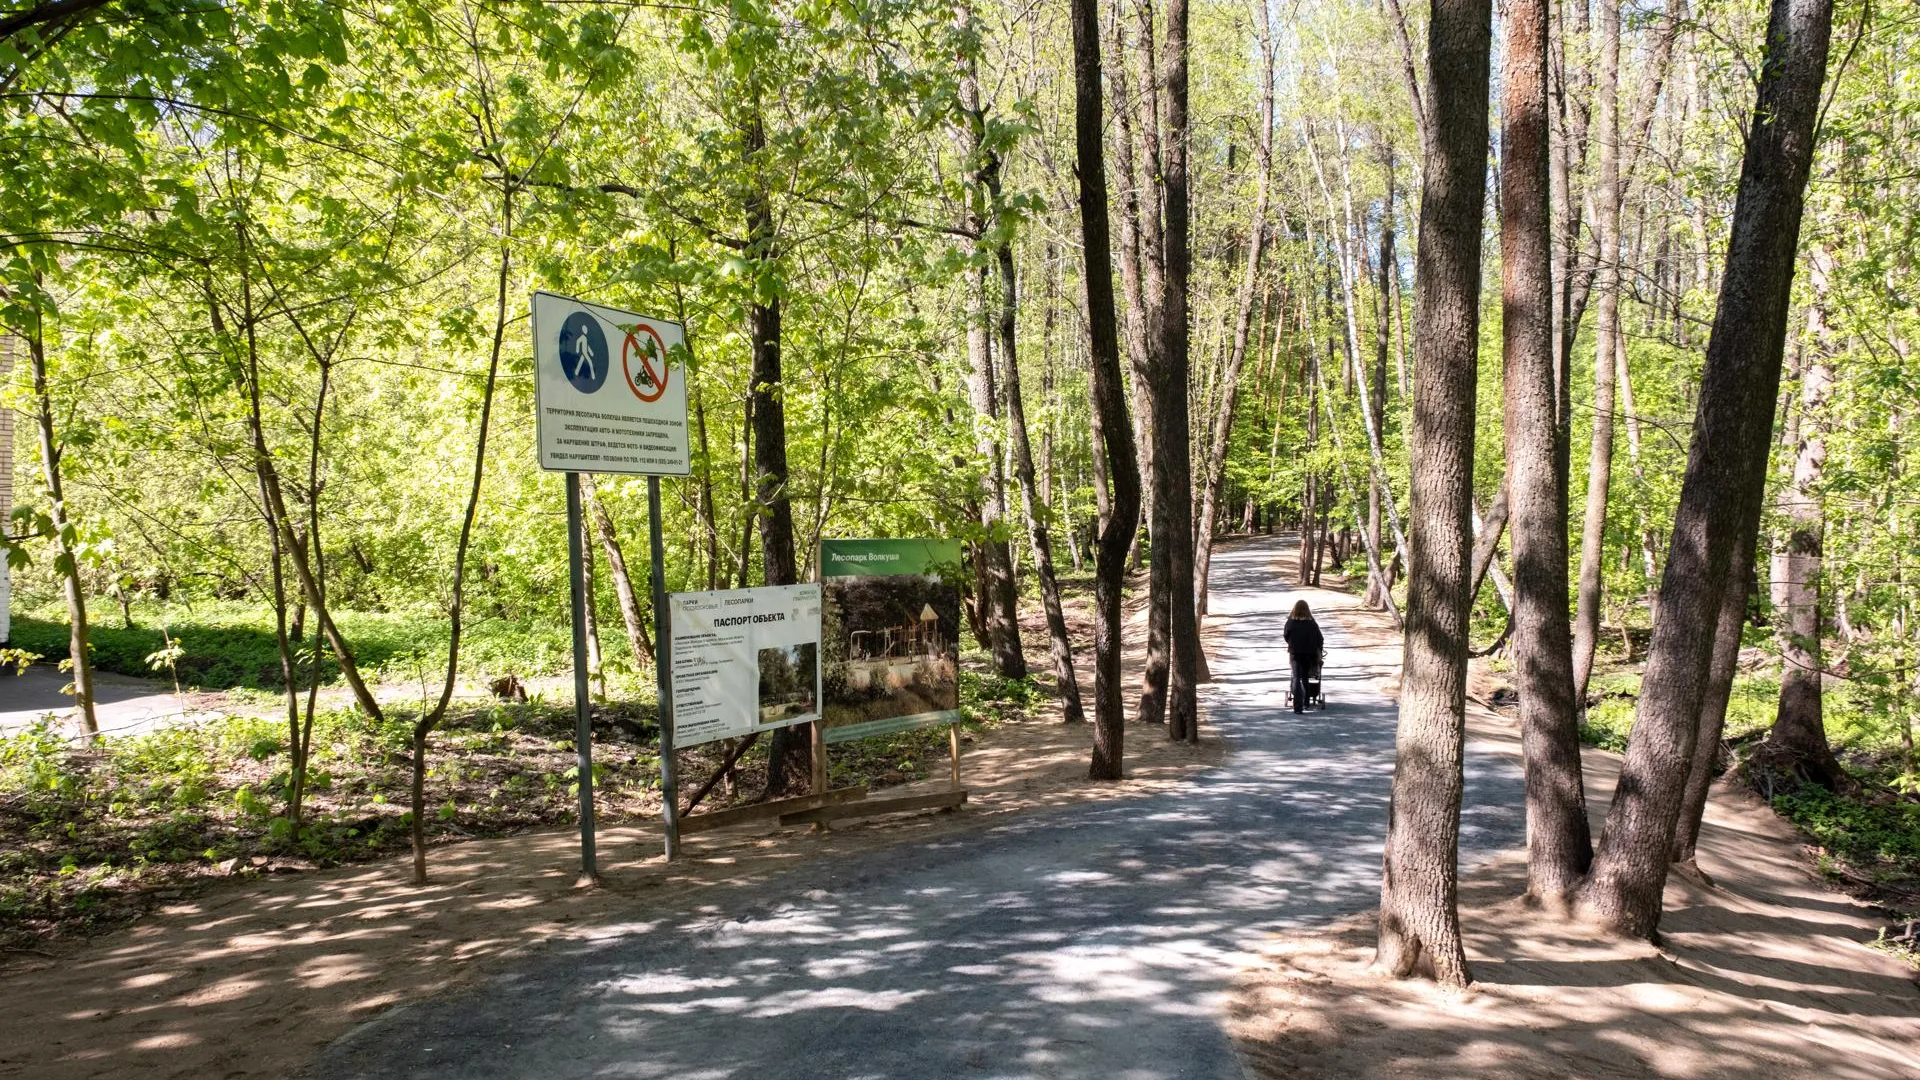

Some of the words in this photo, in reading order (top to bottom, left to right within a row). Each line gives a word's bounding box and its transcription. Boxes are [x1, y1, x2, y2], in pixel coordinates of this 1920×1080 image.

[556, 437, 563, 445] ЗА
[831, 552, 868, 563] Лесопарк
[868, 553, 900, 562] Волкуша
[724, 598, 754, 606] ЛЕСОПАРКИ
[713, 616, 751, 628] ПАСПОРТ
[752, 612, 785, 624] ОБЪЕКТА
